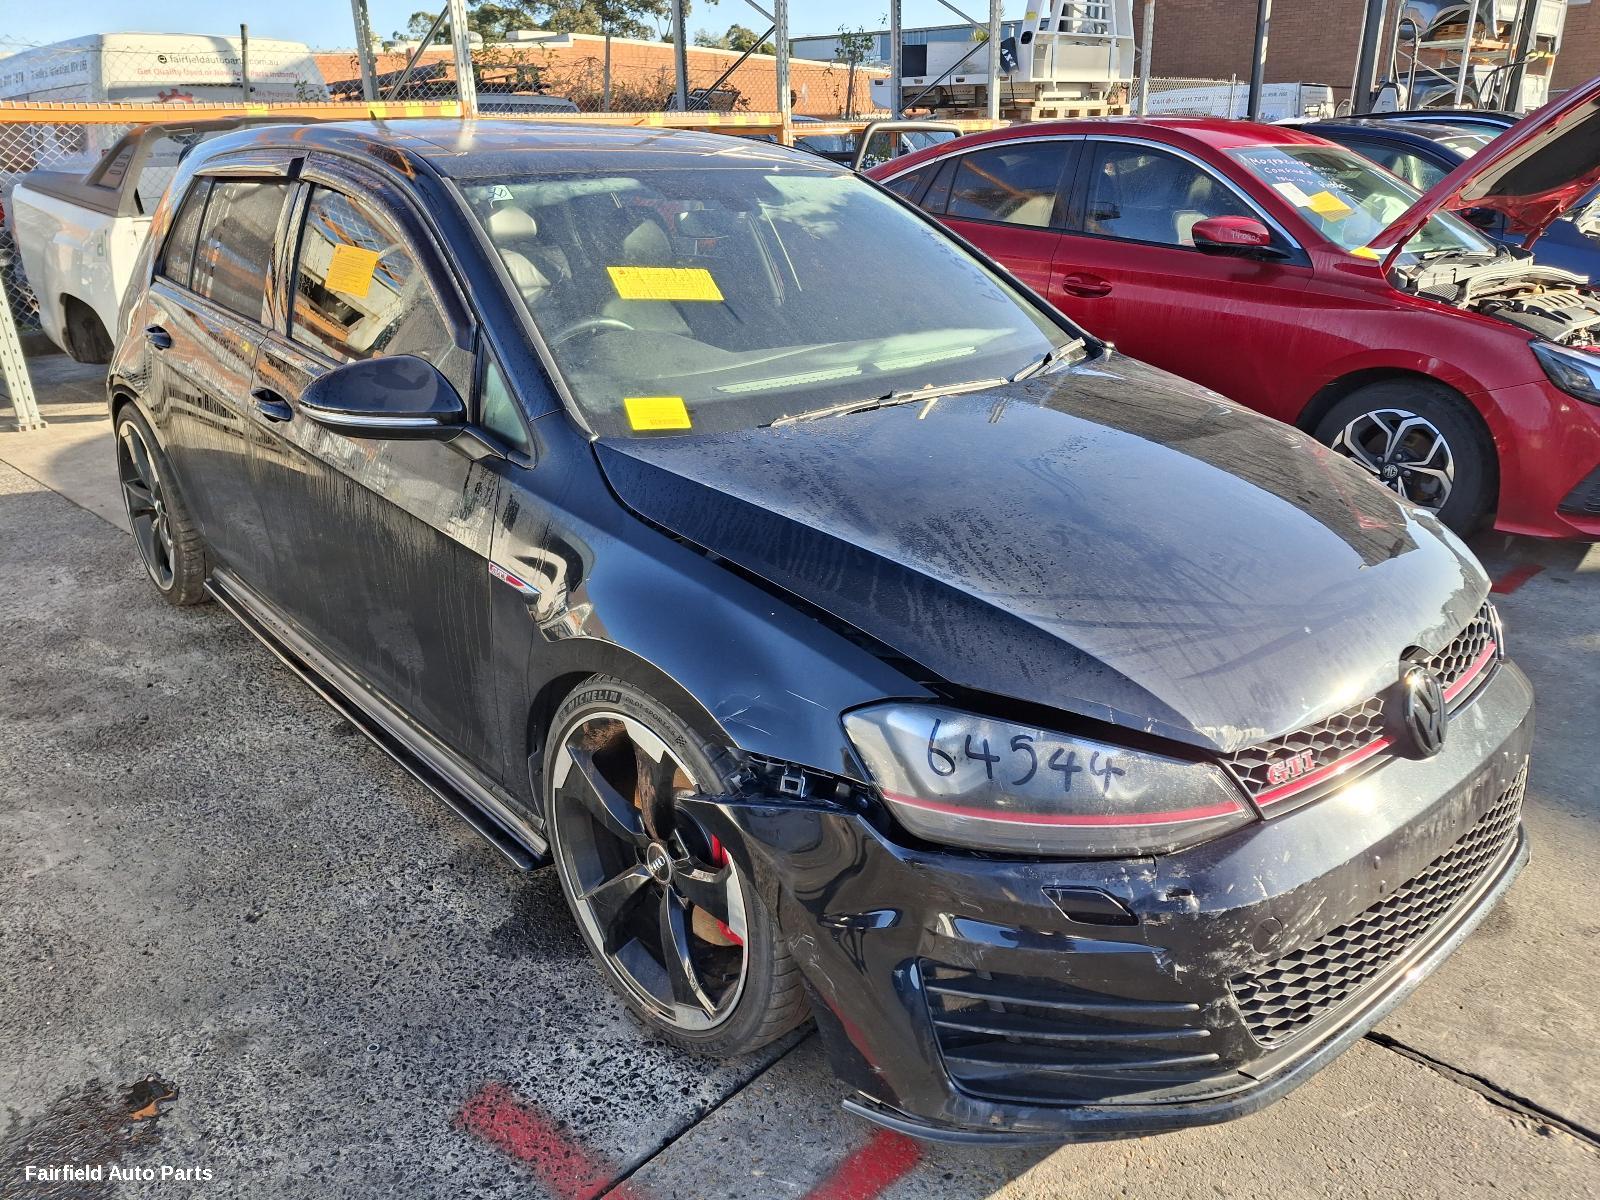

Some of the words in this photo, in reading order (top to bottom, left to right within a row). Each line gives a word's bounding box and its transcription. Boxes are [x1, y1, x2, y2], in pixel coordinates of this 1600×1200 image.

[169, 55, 279, 66] fairfieldautopartcom.au
[568, 689, 618, 711] MICHELIN
[928, 718, 1126, 794] 64544
[1267, 749, 1315, 784] GTI
